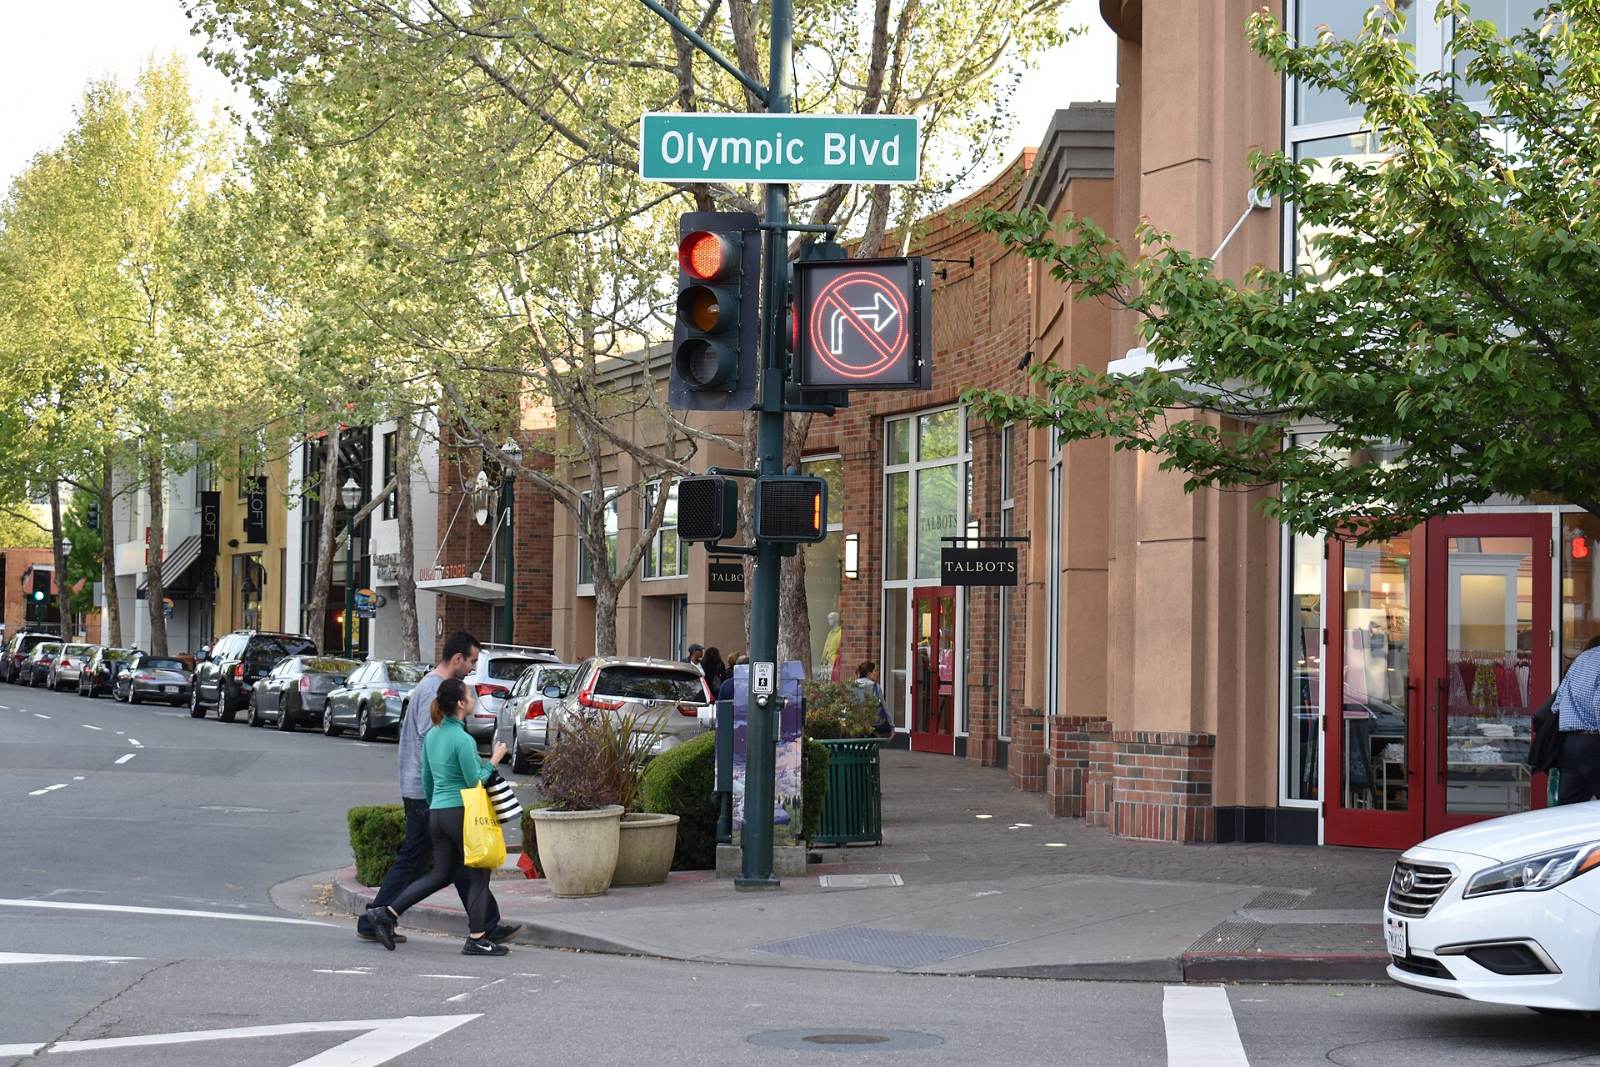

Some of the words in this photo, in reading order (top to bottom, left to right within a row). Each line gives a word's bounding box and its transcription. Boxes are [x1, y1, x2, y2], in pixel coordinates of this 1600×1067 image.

[661, 131, 804, 171] Olympic
[824, 132, 900, 166] Blvd
[204, 505, 217, 540] LOFT
[920, 513, 958, 532] TALBOTS
[446, 564, 466, 579] STORE
[944, 561, 1015, 572] TALBOTS
